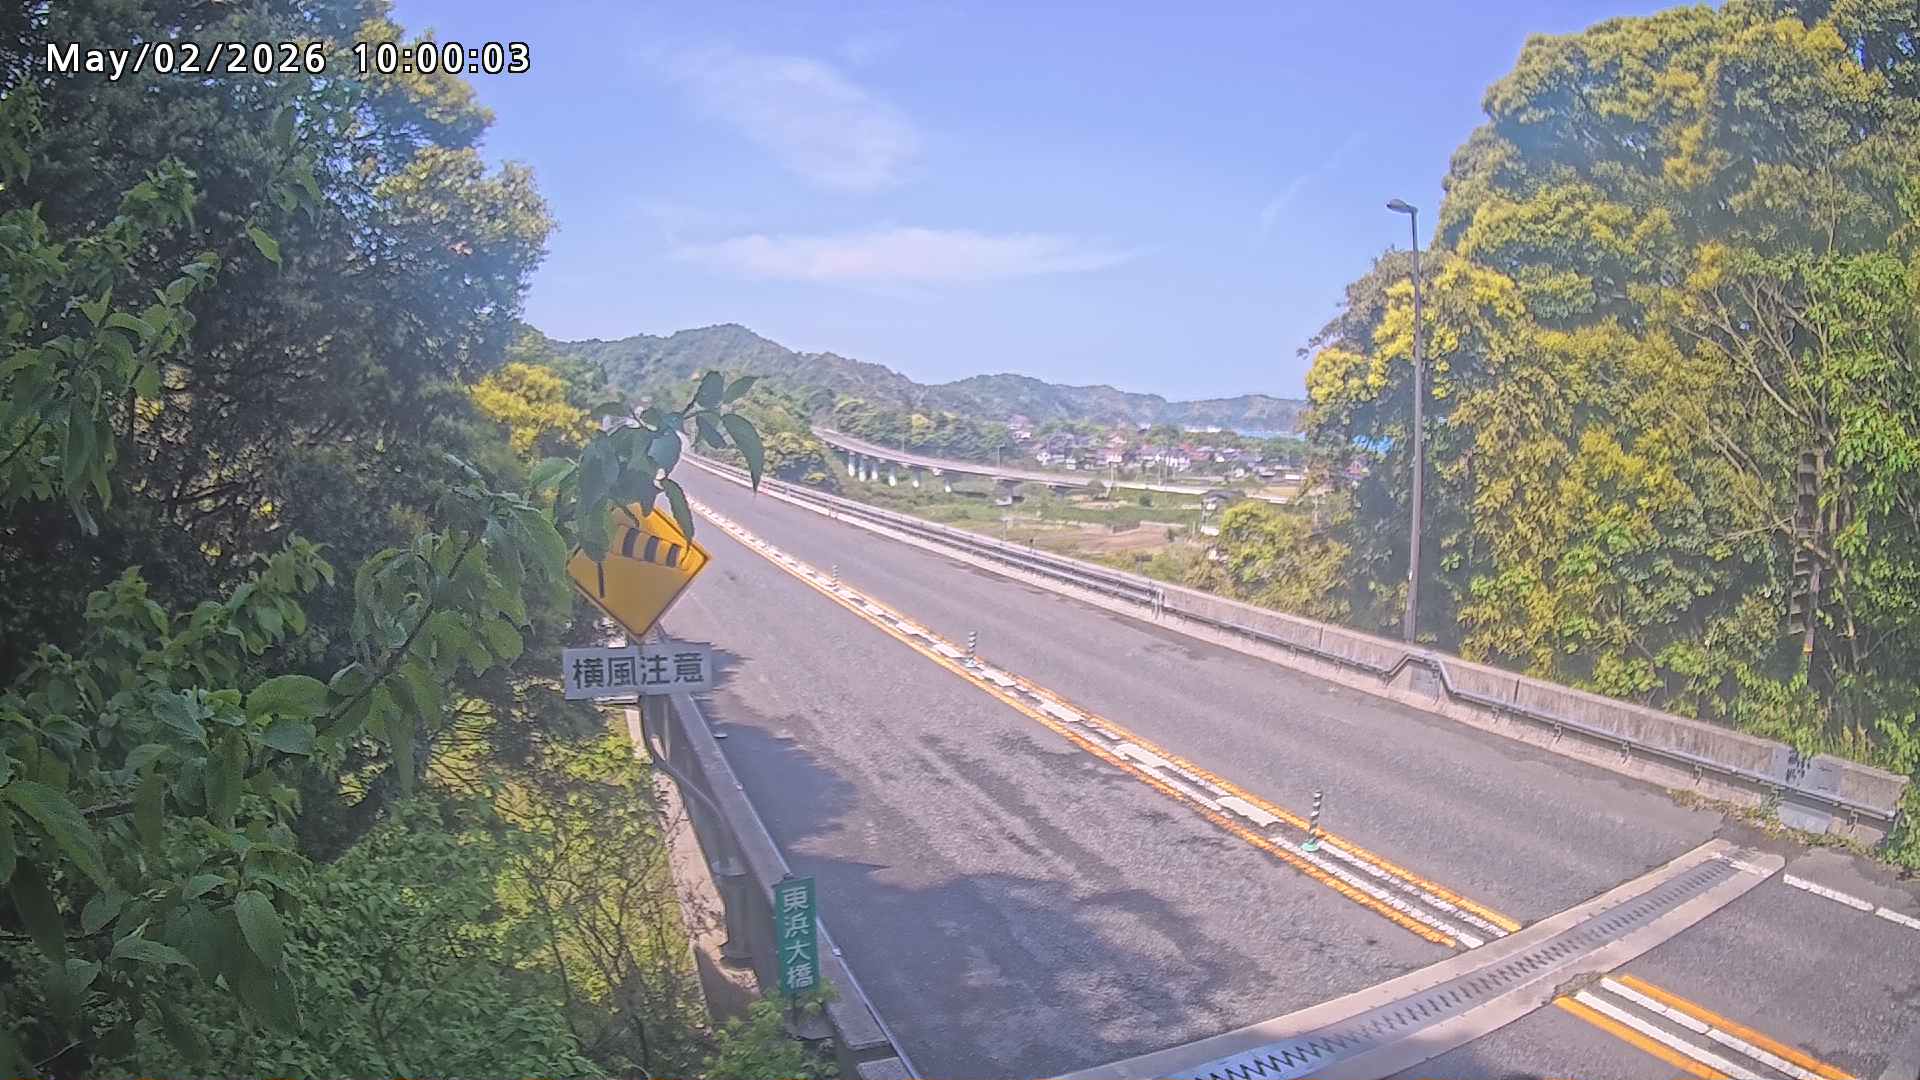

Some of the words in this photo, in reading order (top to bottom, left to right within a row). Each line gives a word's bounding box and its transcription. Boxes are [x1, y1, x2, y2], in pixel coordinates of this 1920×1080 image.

[572, 652, 705, 690] 横風注意
[782, 885, 814, 990] 東浜大橋
